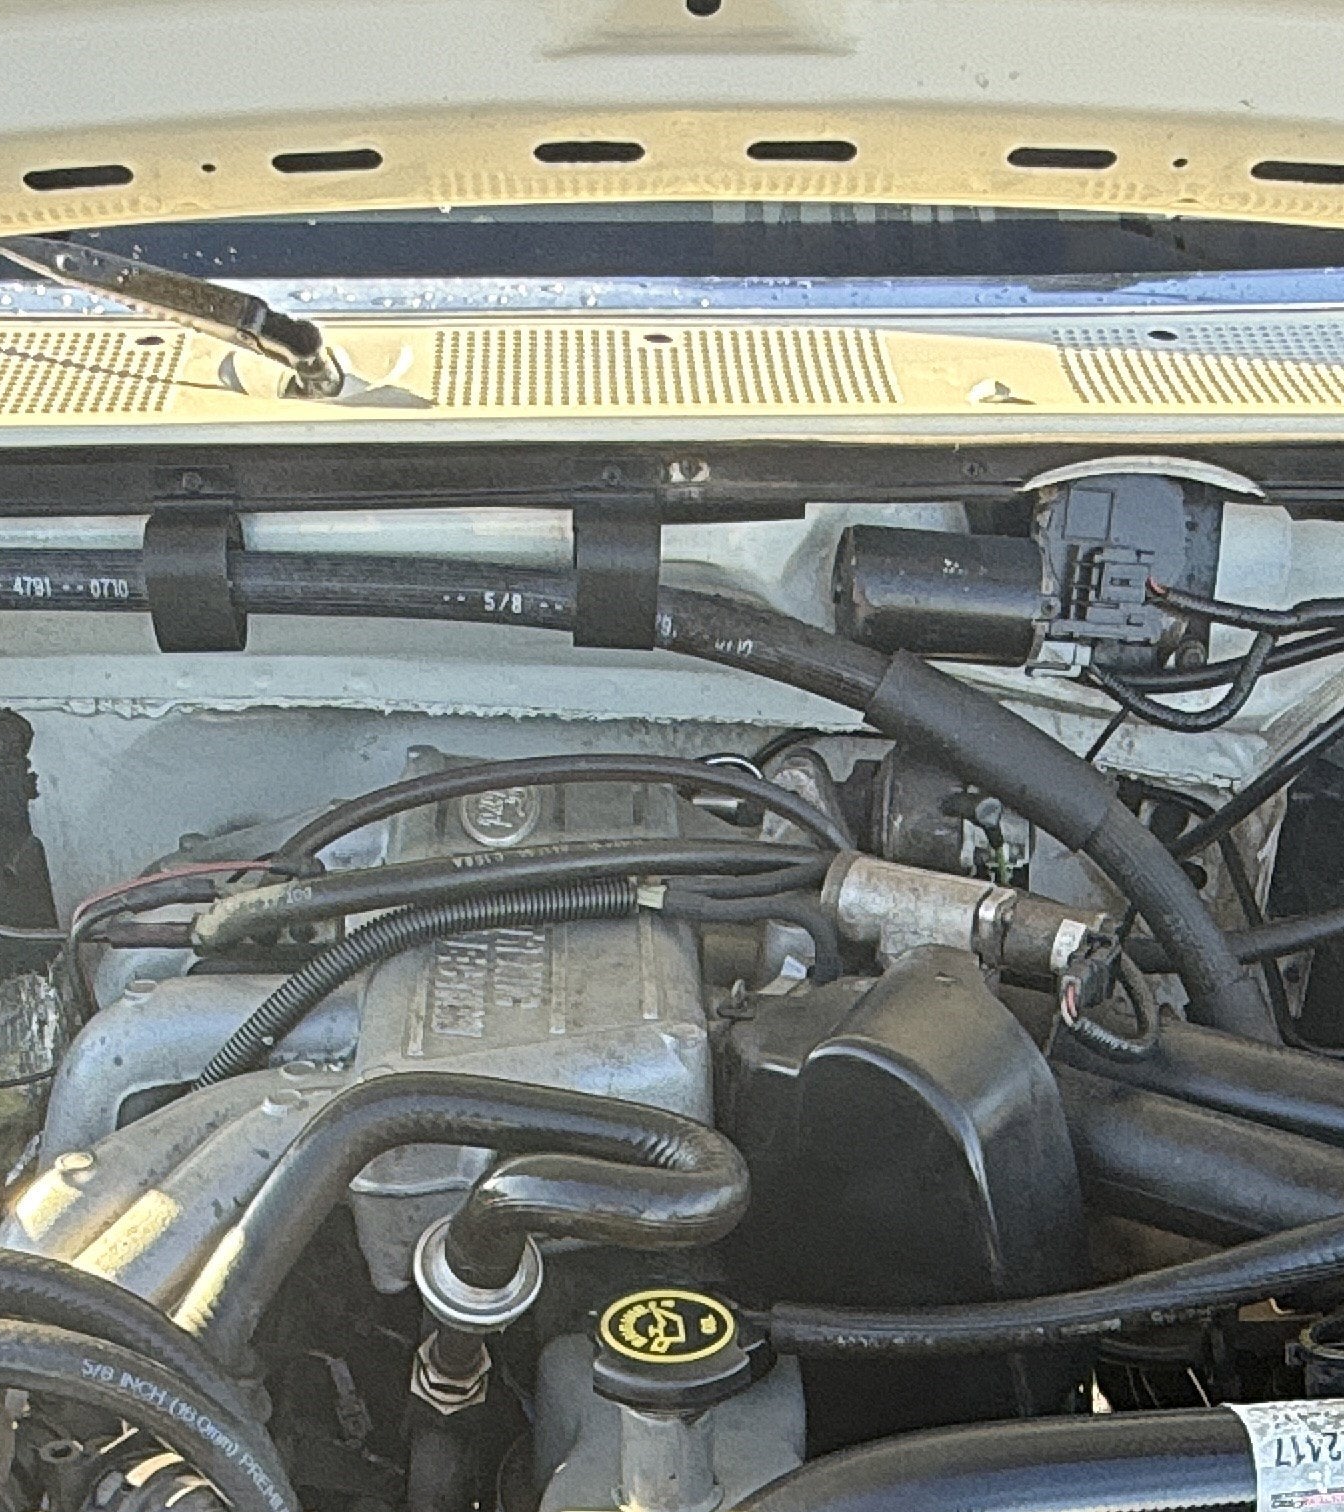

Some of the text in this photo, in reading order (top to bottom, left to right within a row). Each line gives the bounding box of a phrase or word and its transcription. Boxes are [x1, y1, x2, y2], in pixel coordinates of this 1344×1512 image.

[12, 576, 52, 598] 4791
[484, 591, 522, 613] 5/8
[81, 1359, 115, 1383] 5/8
[120, 1372, 167, 1405] INCH
